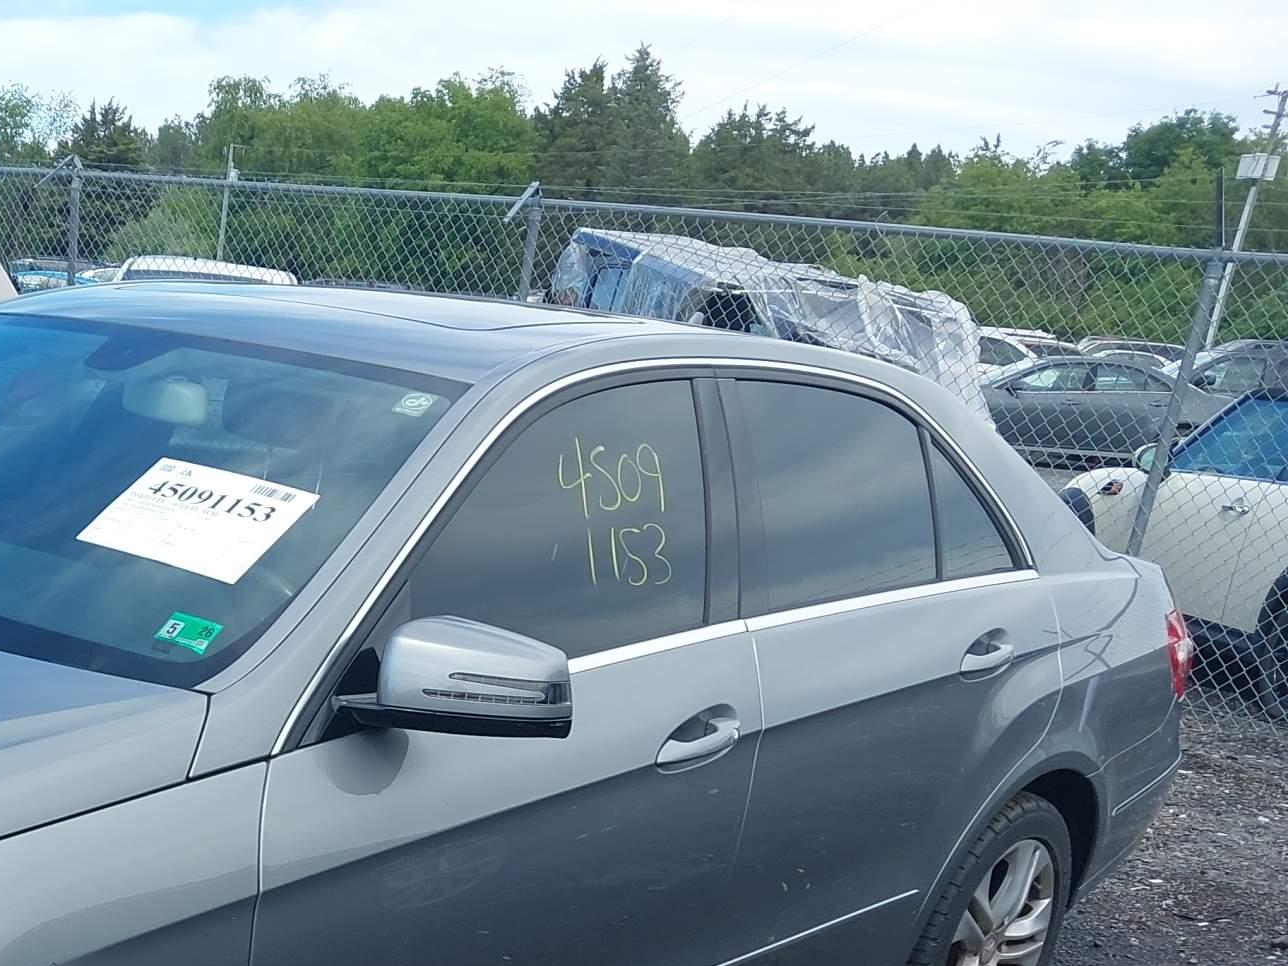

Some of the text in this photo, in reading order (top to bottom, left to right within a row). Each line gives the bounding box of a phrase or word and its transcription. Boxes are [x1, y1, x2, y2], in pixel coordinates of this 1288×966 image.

[148, 480, 277, 523] 45091153
[558, 436, 665, 519] 4509
[587, 523, 672, 585] 1153
[166, 622, 181, 635] 5
